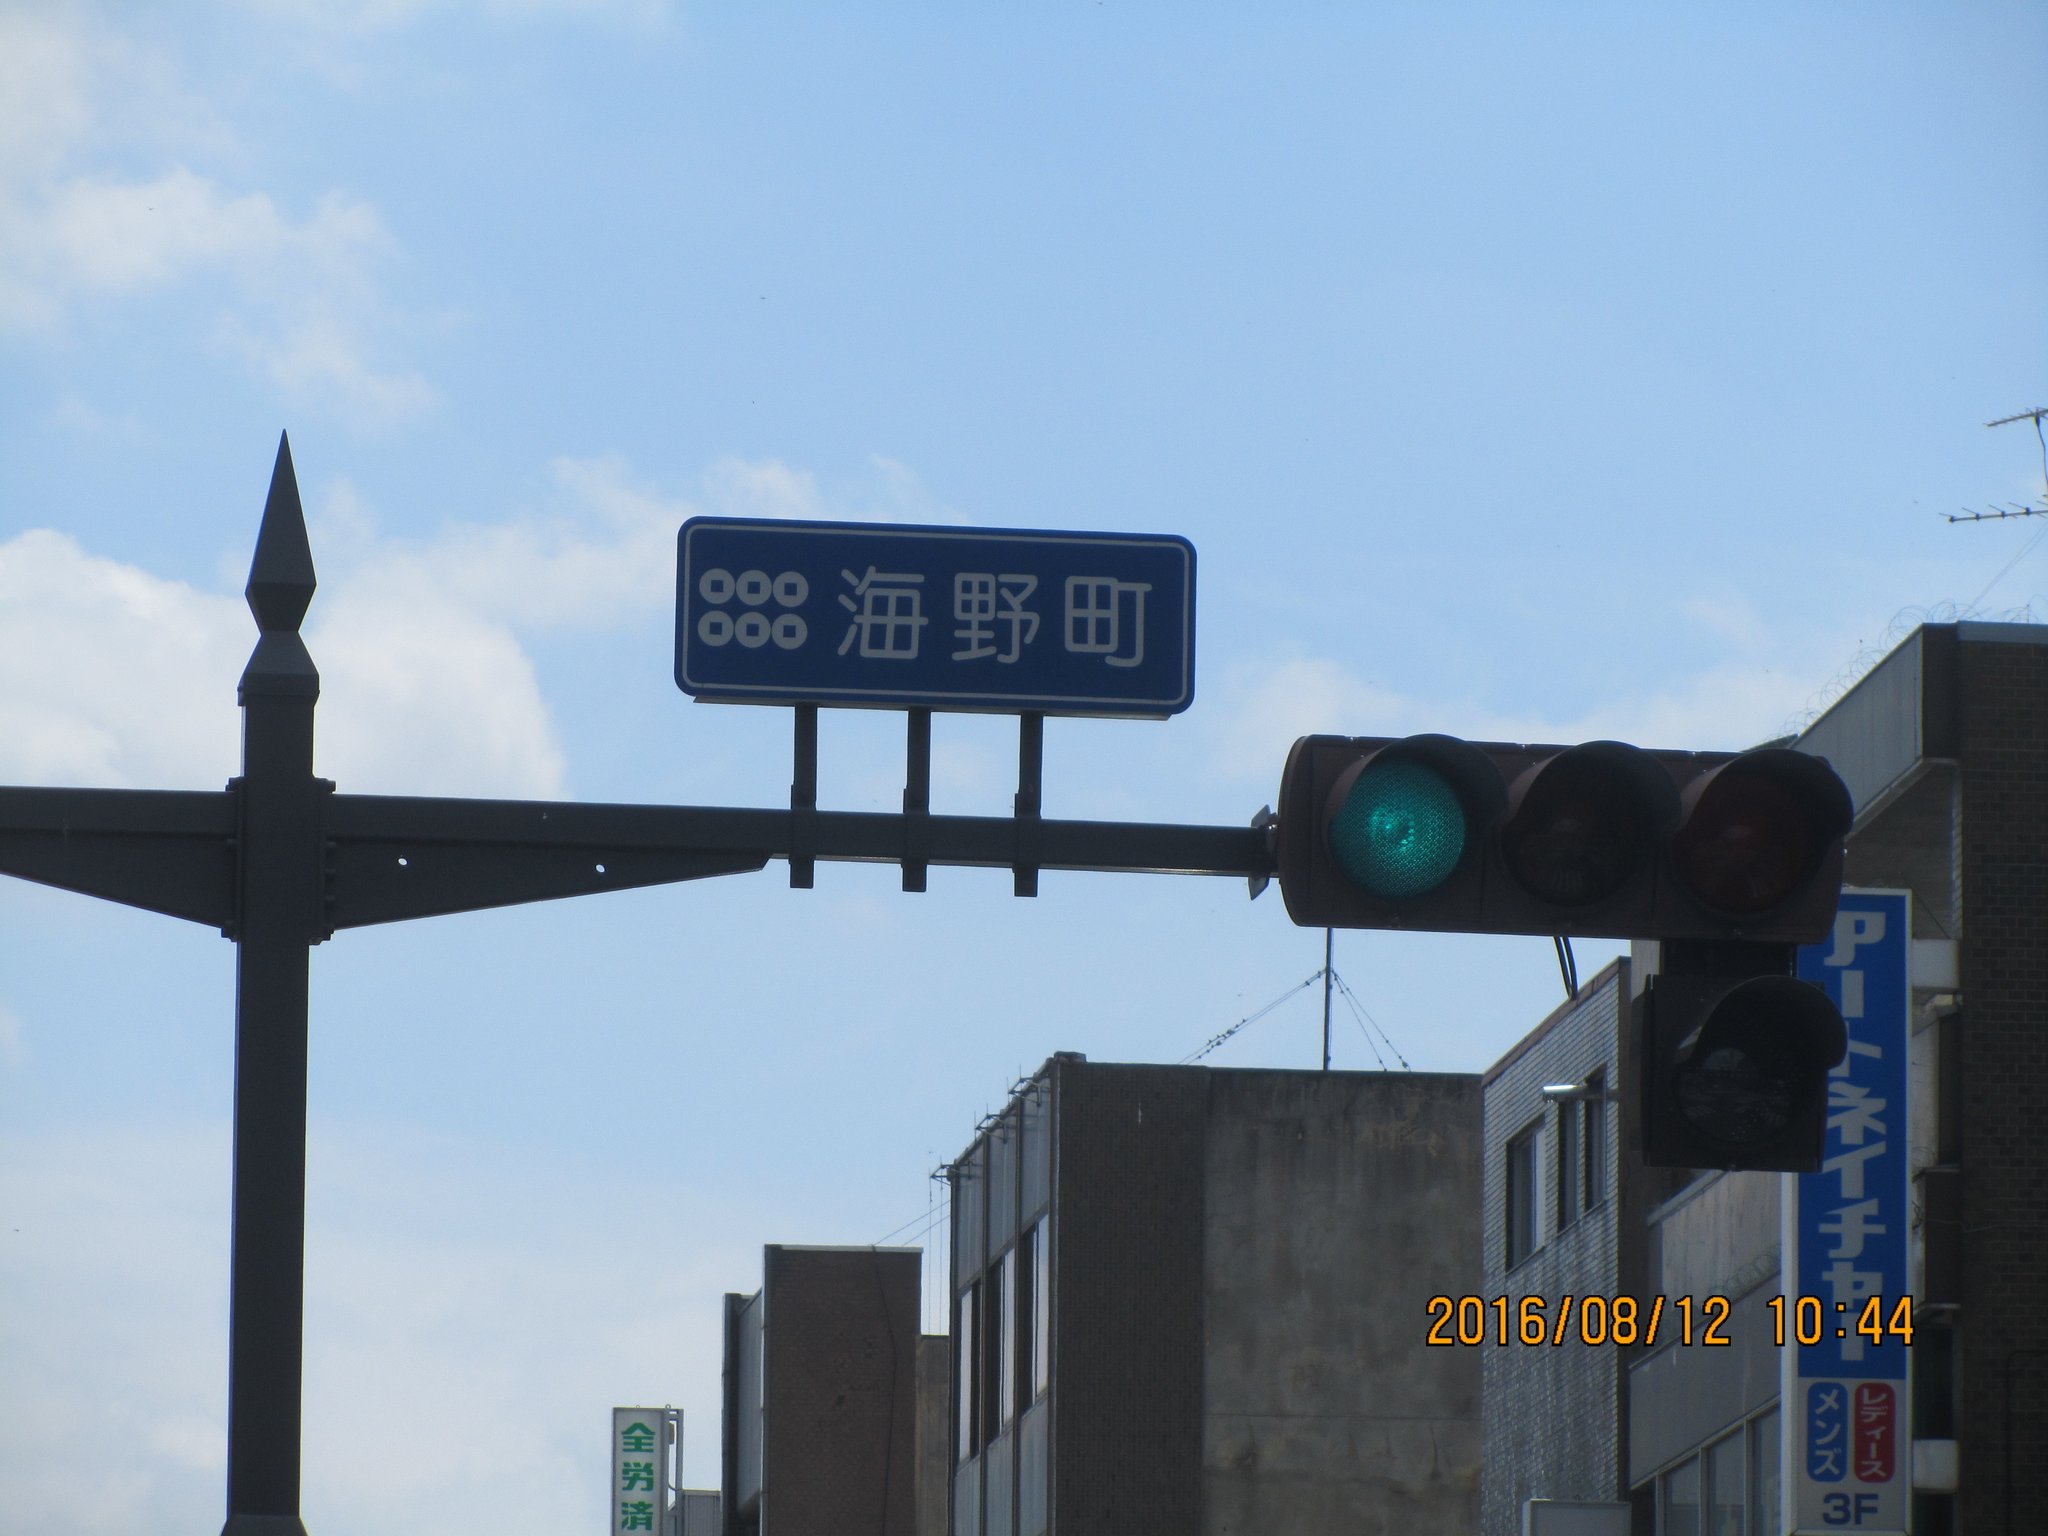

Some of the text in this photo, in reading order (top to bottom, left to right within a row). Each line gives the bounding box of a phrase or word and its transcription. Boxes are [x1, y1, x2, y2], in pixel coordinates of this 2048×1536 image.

[838, 565, 1152, 667] 海野町
[621, 1422, 656, 1531] 全労済
[1814, 1388, 1842, 1476] メンズ
[1860, 1388, 1888, 1477] レディース
[1822, 1492, 1880, 1526] 3F
